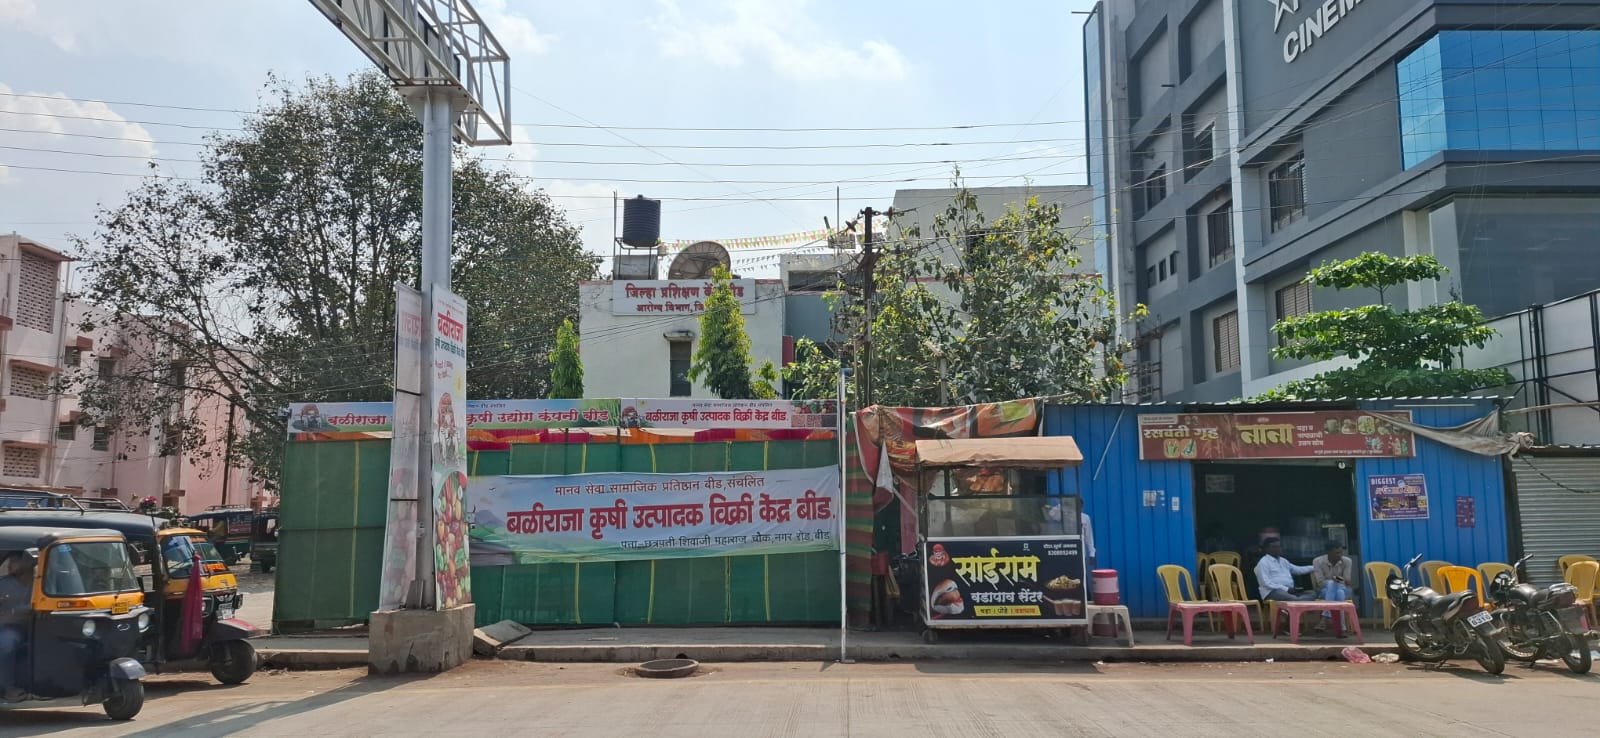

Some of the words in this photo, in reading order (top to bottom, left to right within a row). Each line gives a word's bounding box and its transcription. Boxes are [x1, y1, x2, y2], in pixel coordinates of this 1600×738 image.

[625, 282, 656, 299] जिल्हा
[661, 282, 699, 300] प्रशिक्षण
[636, 301, 662, 312] आरोग्य
[328, 412, 387, 425] बळीराजा
[466, 410, 493, 427] कृषी
[497, 409, 533, 423] उद्योग
[538, 408, 578, 422] कंपनी
[583, 406, 609, 421] बीड
[645, 408, 679, 422] बळीराजा
[681, 408, 698, 424] कृषी
[700, 411, 731, 421] उत्पादक
[733, 408, 752, 421] विक्री
[755, 408, 769, 421] केंद्र
[1143, 425, 1190, 439] रसवंती
[1193, 427, 1219, 440] गृह
[1232, 424, 1296, 445] नाना
[555, 485, 580, 496] मानव
[585, 481, 605, 495] सेवा
[609, 480, 657, 493] सामाजिक
[1371, 477, 1396, 486] BIGGEST
[507, 502, 585, 534] बळीराजा
[589, 498, 628, 540] कृषी
[633, 503, 703, 529] उत्पादक
[709, 492, 754, 526] विक्री
[759, 493, 792, 523] केंद्र
[680, 534, 711, 547] शिवाजी
[714, 535, 747, 546] महाराज
[775, 533, 792, 542] नगर
[814, 529, 831, 540] बीड
[951, 547, 1041, 591] साईराम
[971, 591, 1015, 604] वडापाव
[1018, 588, 1044, 604] सेंटर
